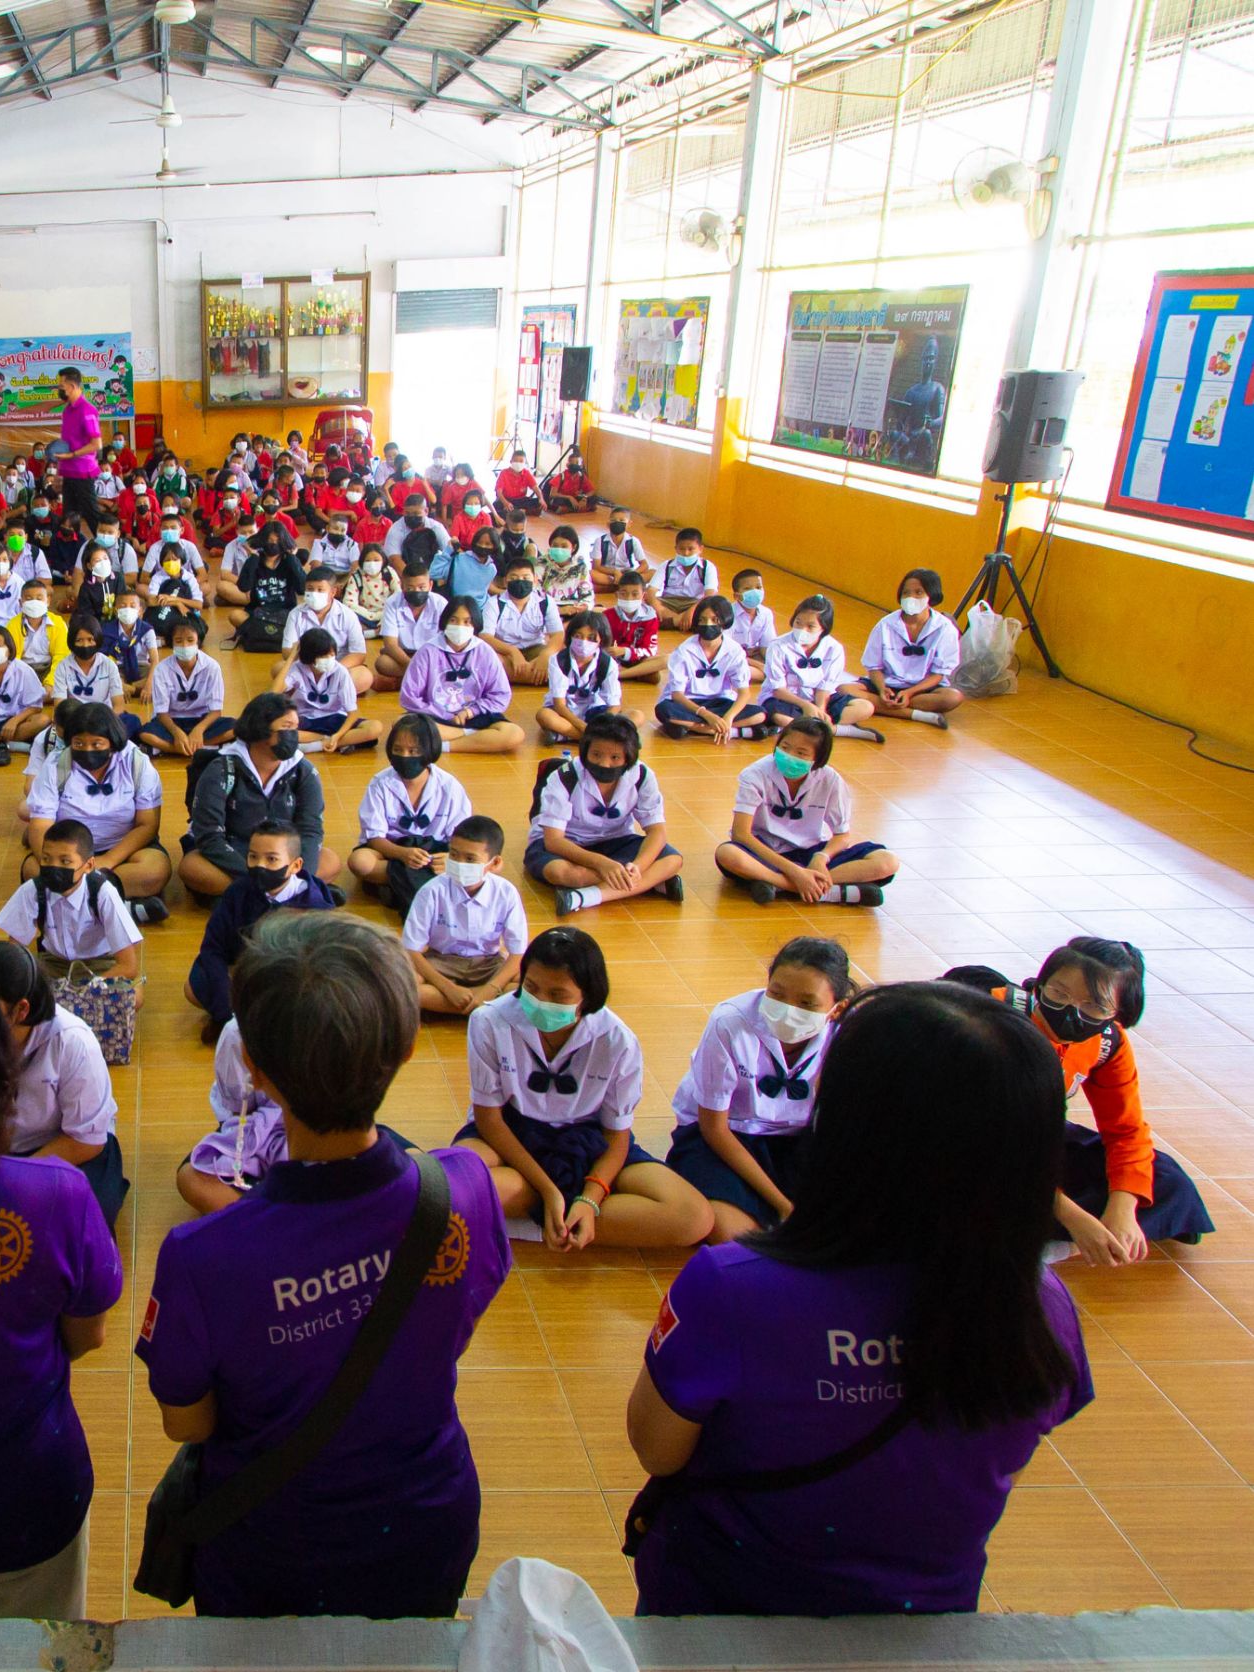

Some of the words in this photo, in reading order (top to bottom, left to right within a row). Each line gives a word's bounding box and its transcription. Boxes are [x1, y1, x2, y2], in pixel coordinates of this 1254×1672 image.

[910, 309, 952, 327] กรกฎาคม
[273, 1249, 392, 1312] Rotary
[268, 1308, 345, 1345] District
[816, 1379, 905, 1404] District
